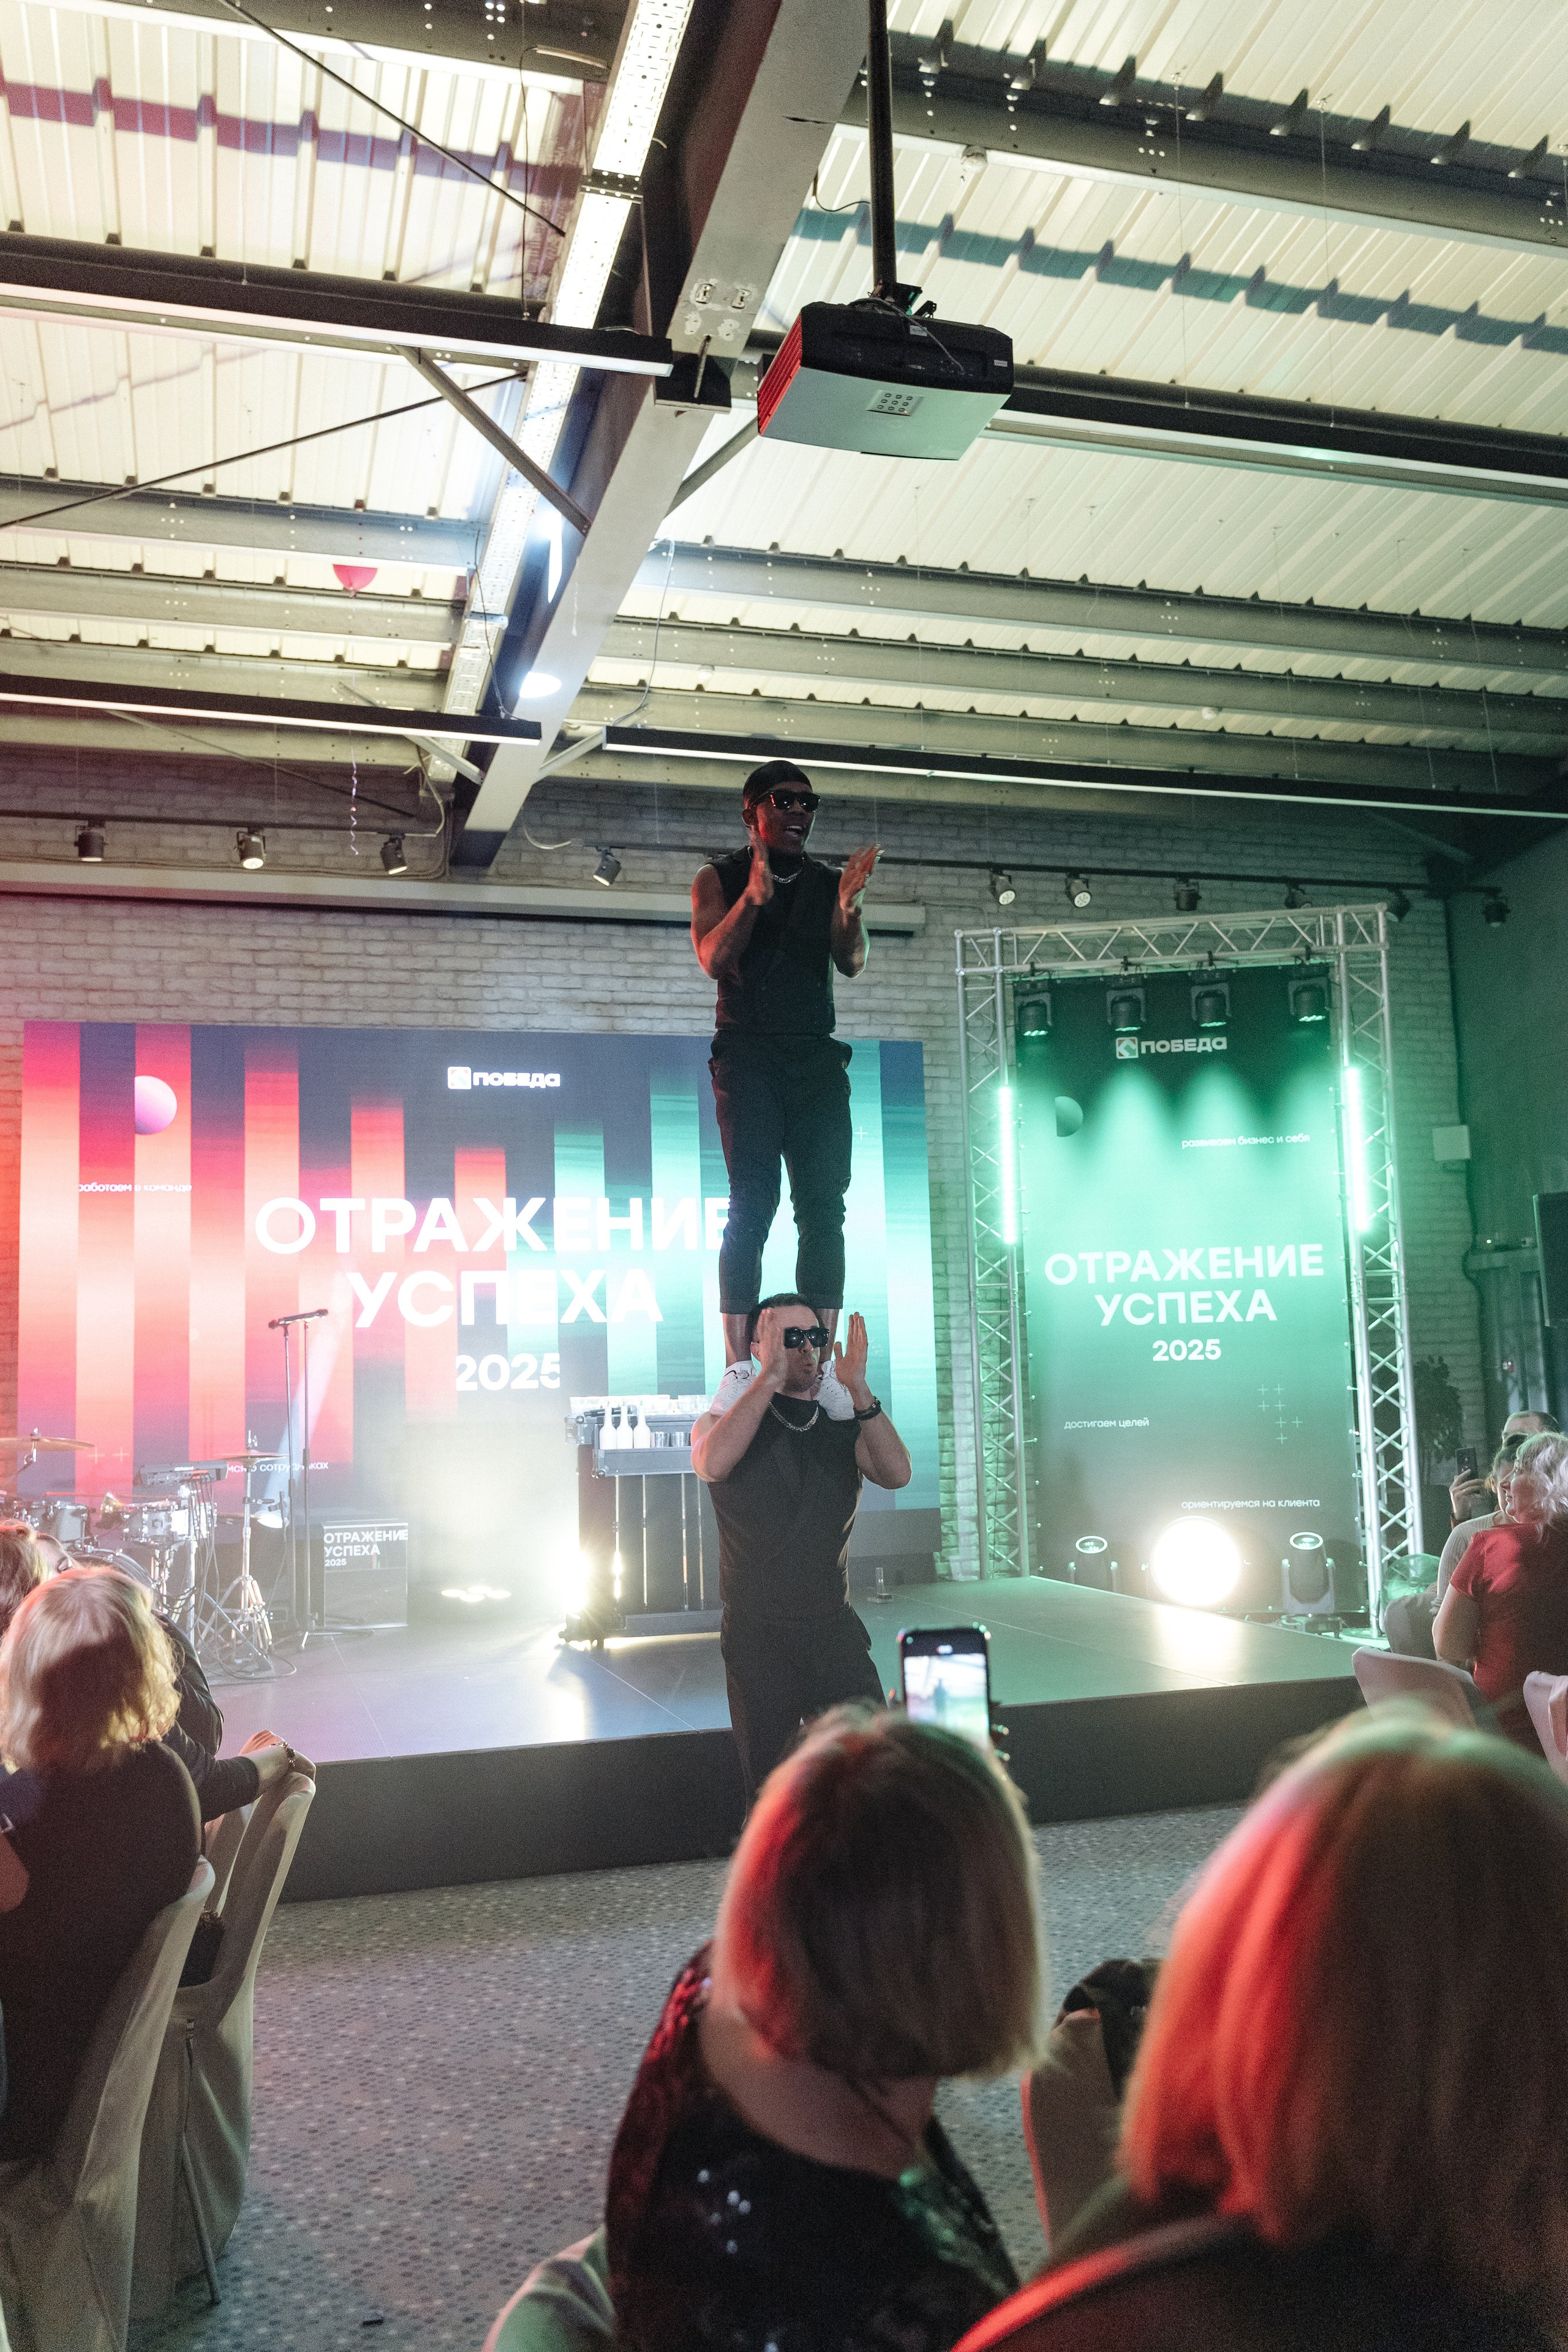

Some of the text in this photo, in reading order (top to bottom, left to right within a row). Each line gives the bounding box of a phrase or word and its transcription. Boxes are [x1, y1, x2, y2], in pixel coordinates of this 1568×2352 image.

[1237, 1136, 1275, 1145] бизнес
[1285, 1133, 1310, 1144] себя
[143, 1183, 192, 1193] команде
[255, 1197, 731, 1254] ОТРАЖЕНИЕ
[1044, 1243, 1324, 1286] ОТРАЖЕНИЕ
[346, 1268, 663, 1328] УСПЕХА
[1094, 1289, 1278, 1326] УСПЕХА
[1152, 1338, 1222, 1361] 2025
[455, 1352, 560, 1391] 2025
[1064, 1417, 1150, 1430] достигаем целей
[259, 1461, 329, 1473] сотруднках
[1181, 1499, 1260, 1510] ориентируемся
[1278, 1499, 1321, 1507] клиента
[323, 1529, 409, 1544] ОТРАЖЕНИЕ
[323, 1544, 381, 1557] УСПЕХА
[324, 1558, 347, 1567] 2025
